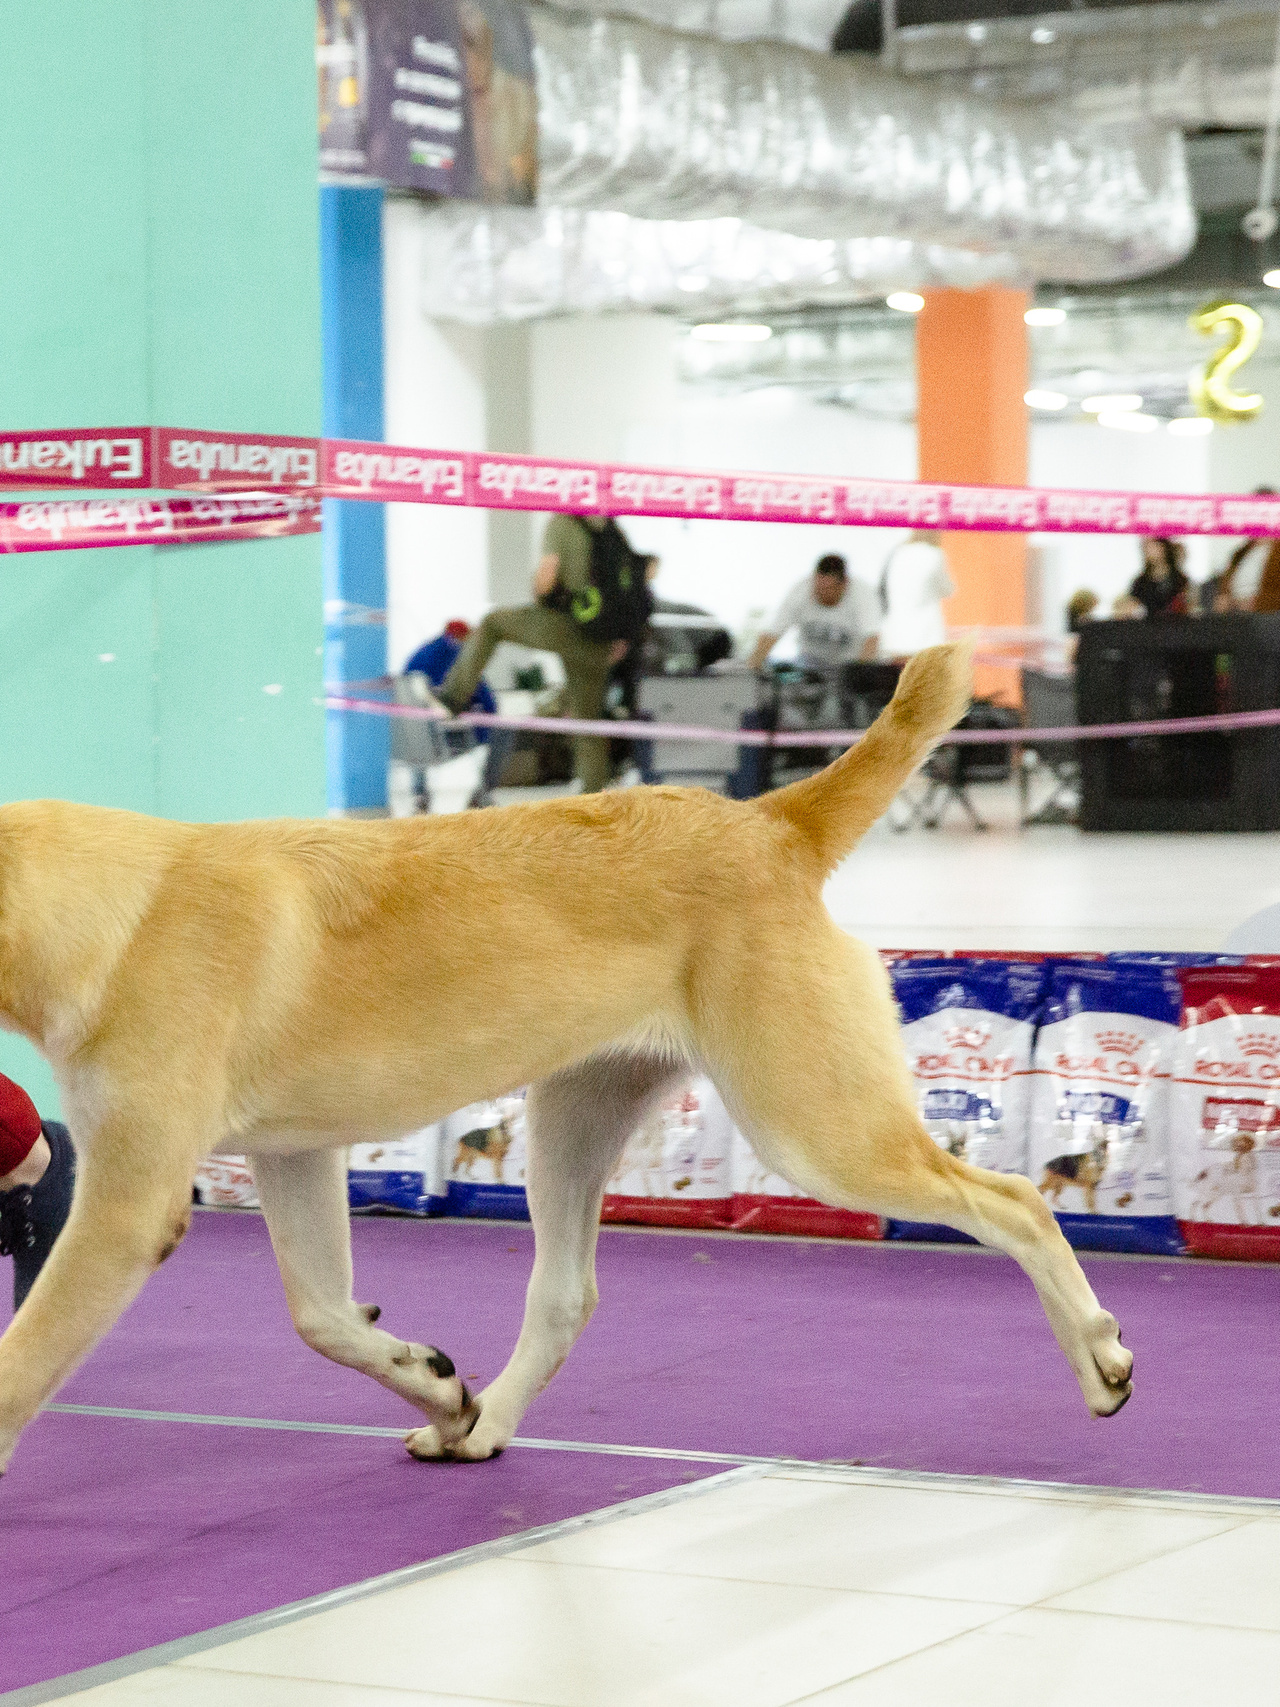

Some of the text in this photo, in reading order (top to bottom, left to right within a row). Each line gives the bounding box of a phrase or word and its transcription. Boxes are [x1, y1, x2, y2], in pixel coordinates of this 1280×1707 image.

[170, 439, 317, 486] Eukanuba
[335, 451, 464, 497] Eukanuba
[480, 462, 597, 507] Eukanuba
[611, 471, 721, 512] Eukanuba
